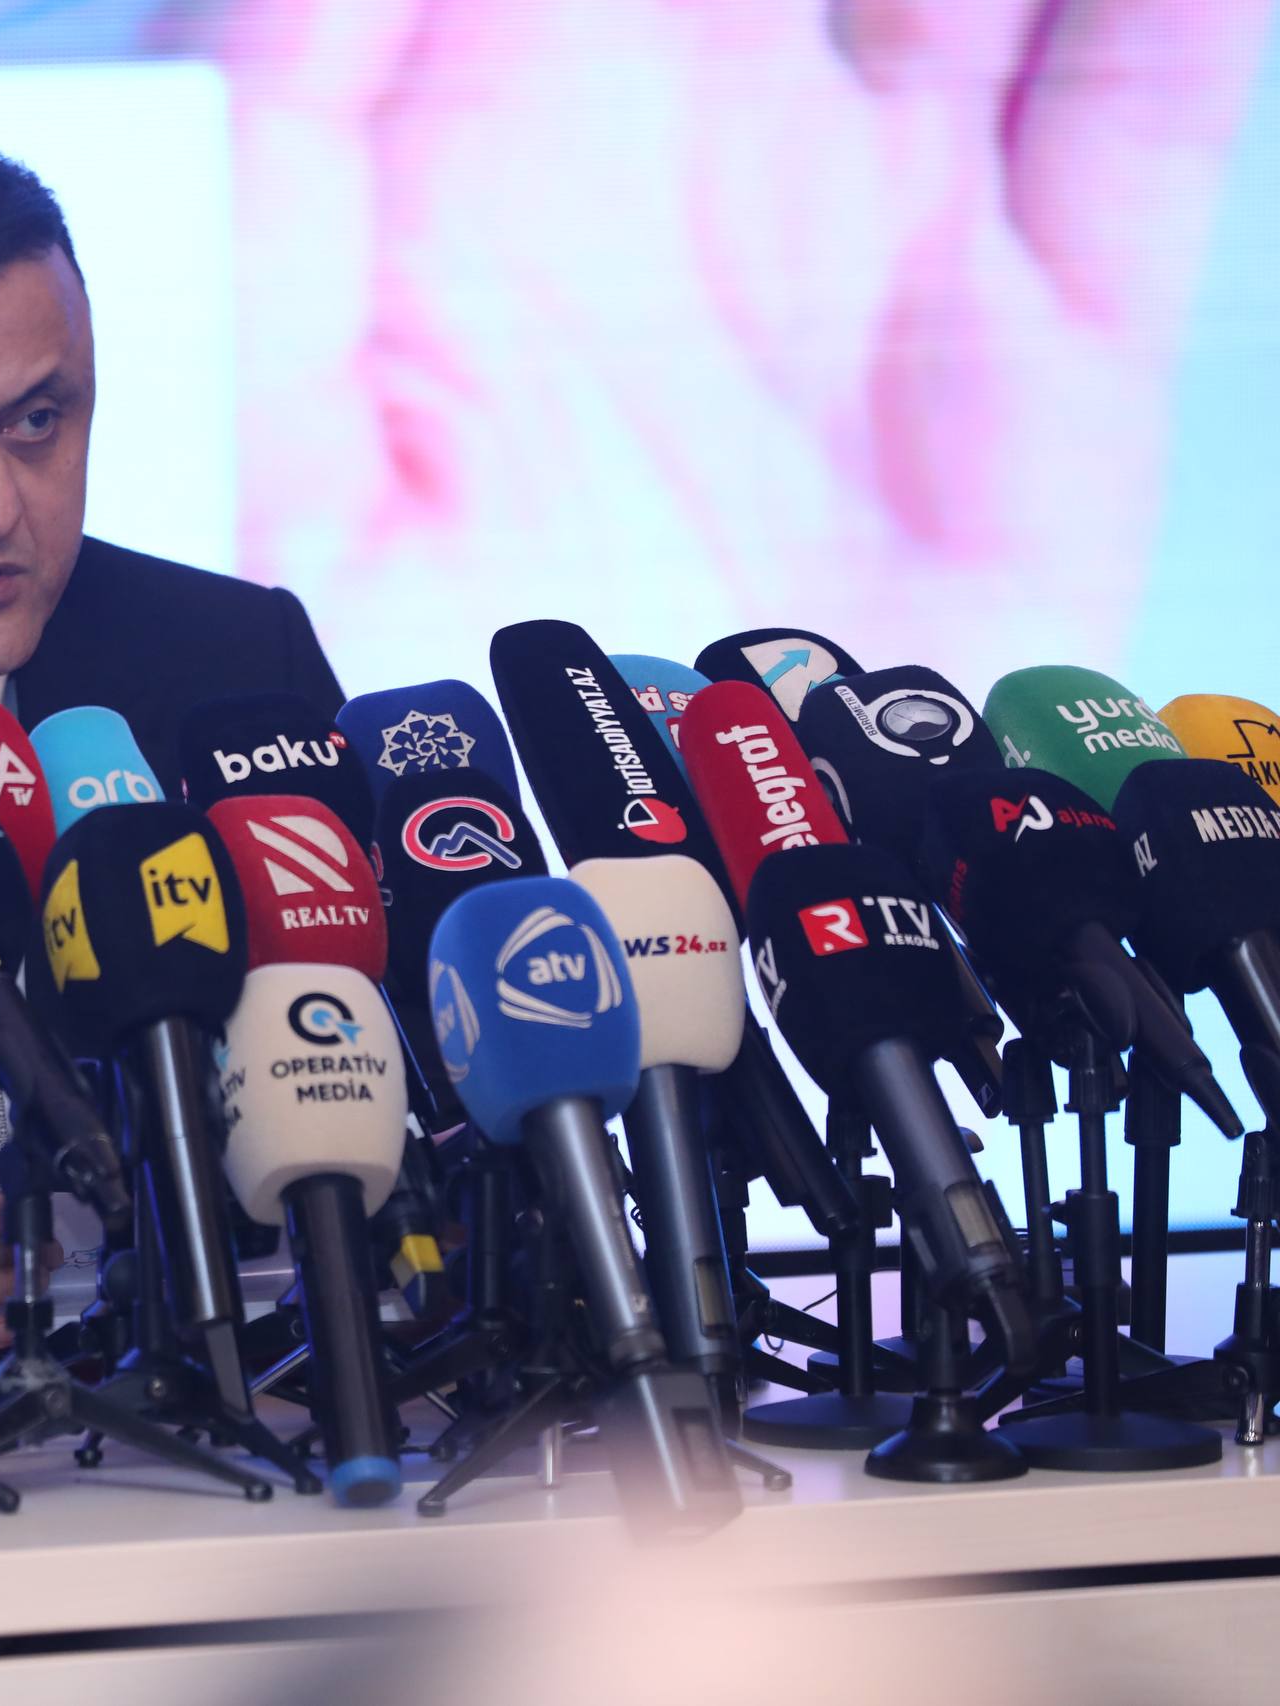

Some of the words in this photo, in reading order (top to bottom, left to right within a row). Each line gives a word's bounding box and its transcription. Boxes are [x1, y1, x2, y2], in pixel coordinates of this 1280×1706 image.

[844, 696, 878, 737] BAROMETR
[1083, 722, 1184, 754] media
[213, 734, 340, 784] baku
[715, 724, 820, 851] eleqraf
[148, 868, 212, 908] itv
[624, 936, 671, 958] WS
[883, 933, 939, 950] REKORD
[527, 950, 587, 985] atv
[271, 1053, 388, 1080] OPERATİV
[296, 1080, 374, 1104] MEDİA
